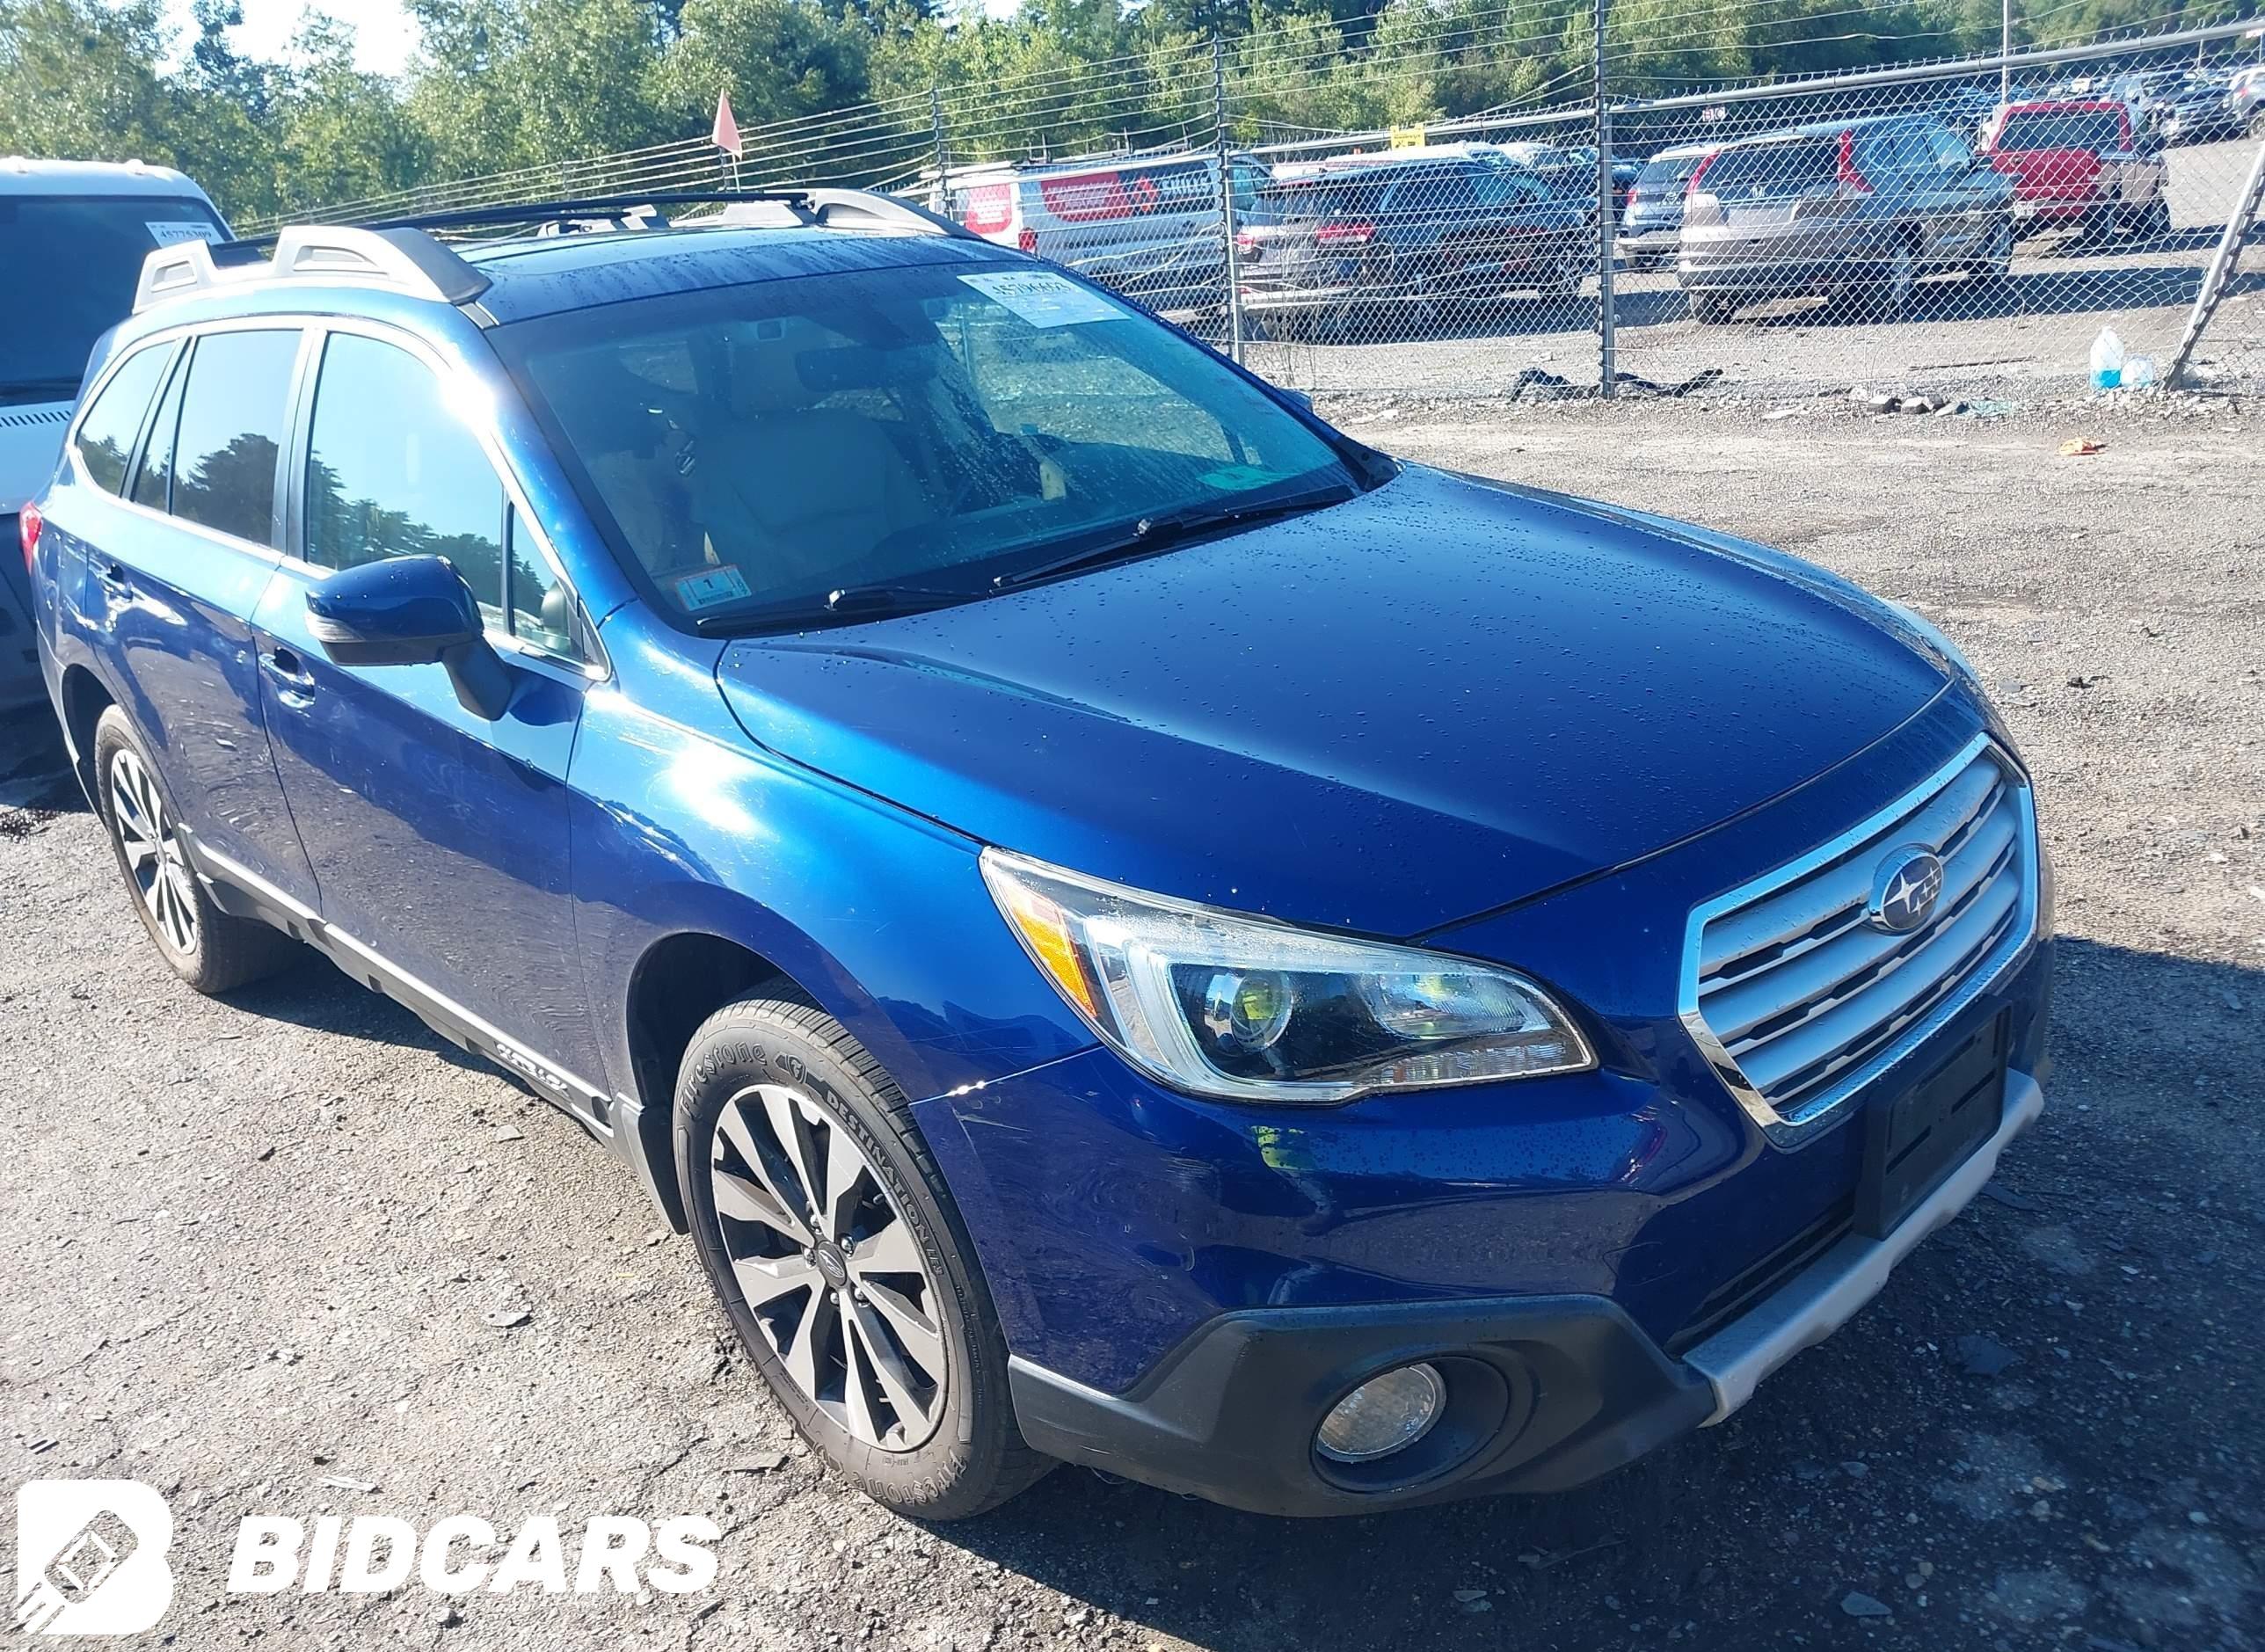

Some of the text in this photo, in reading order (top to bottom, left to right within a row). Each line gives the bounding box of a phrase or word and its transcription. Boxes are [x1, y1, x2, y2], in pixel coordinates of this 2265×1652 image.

[680, 1041, 768, 1119] Firestone
[827, 1089, 930, 1242] DESTINATION
[850, 1446, 967, 1506] Firestone
